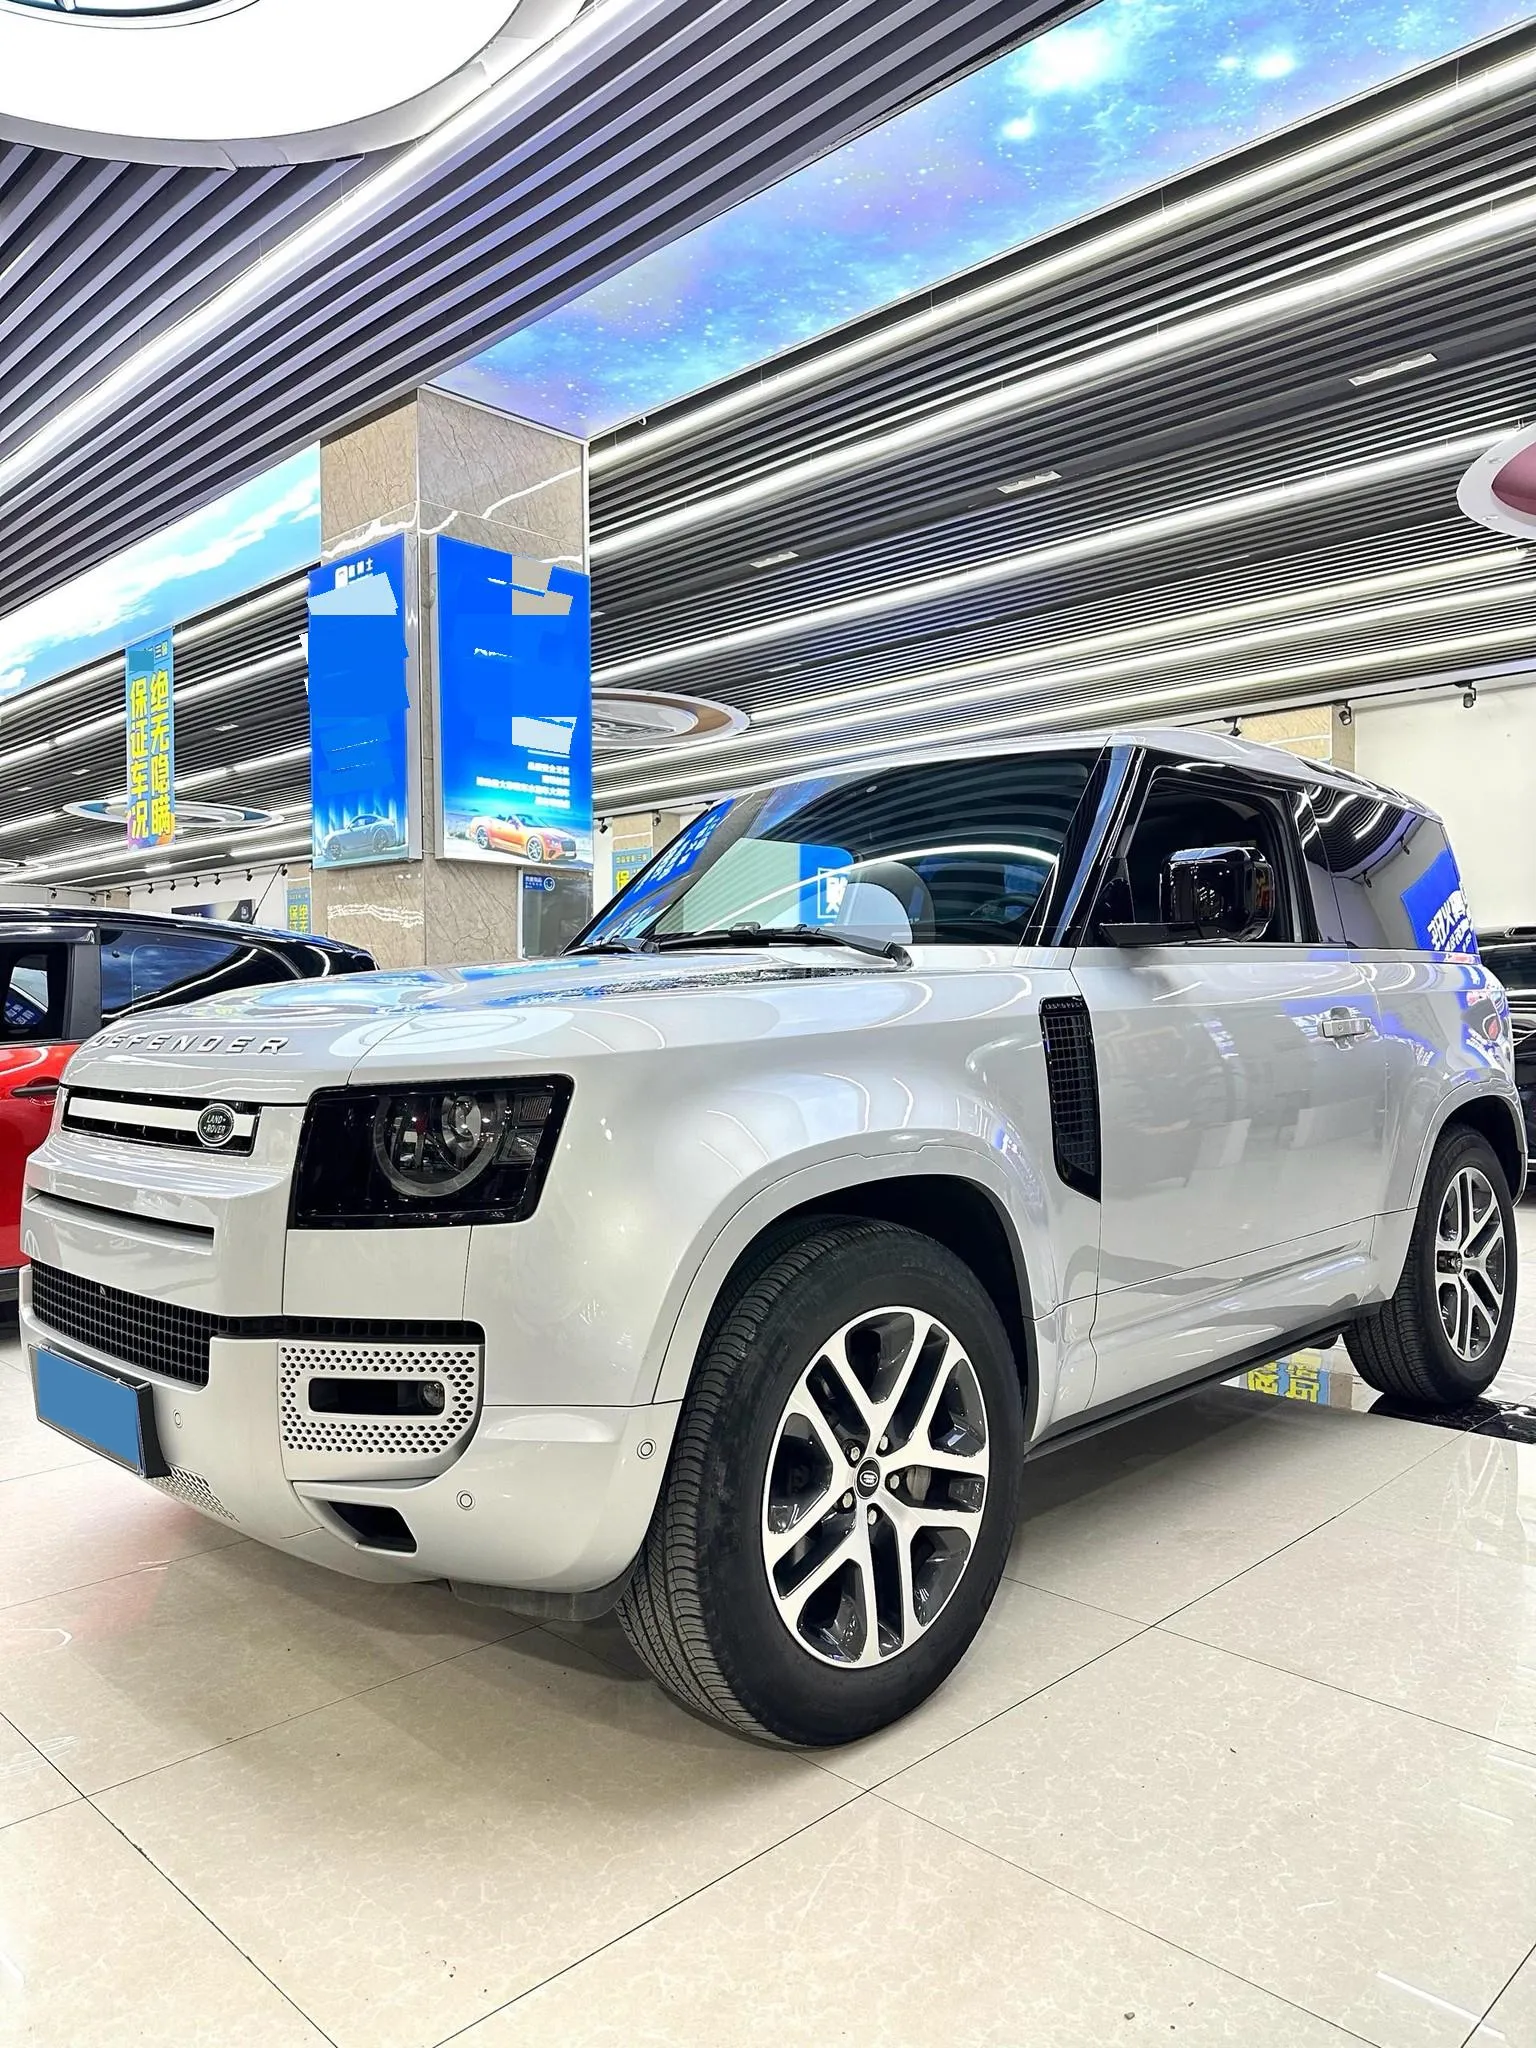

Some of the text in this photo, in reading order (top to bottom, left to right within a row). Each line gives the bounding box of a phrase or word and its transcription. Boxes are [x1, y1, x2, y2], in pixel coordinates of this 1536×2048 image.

[130, 676, 148, 839] 保证车况
[150, 670, 171, 836] 绝无隐瞒
[90, 1033, 289, 1055] DEFENDER
[205, 1124, 226, 1134] ROVER
[206, 1114, 224, 1124] LAND
